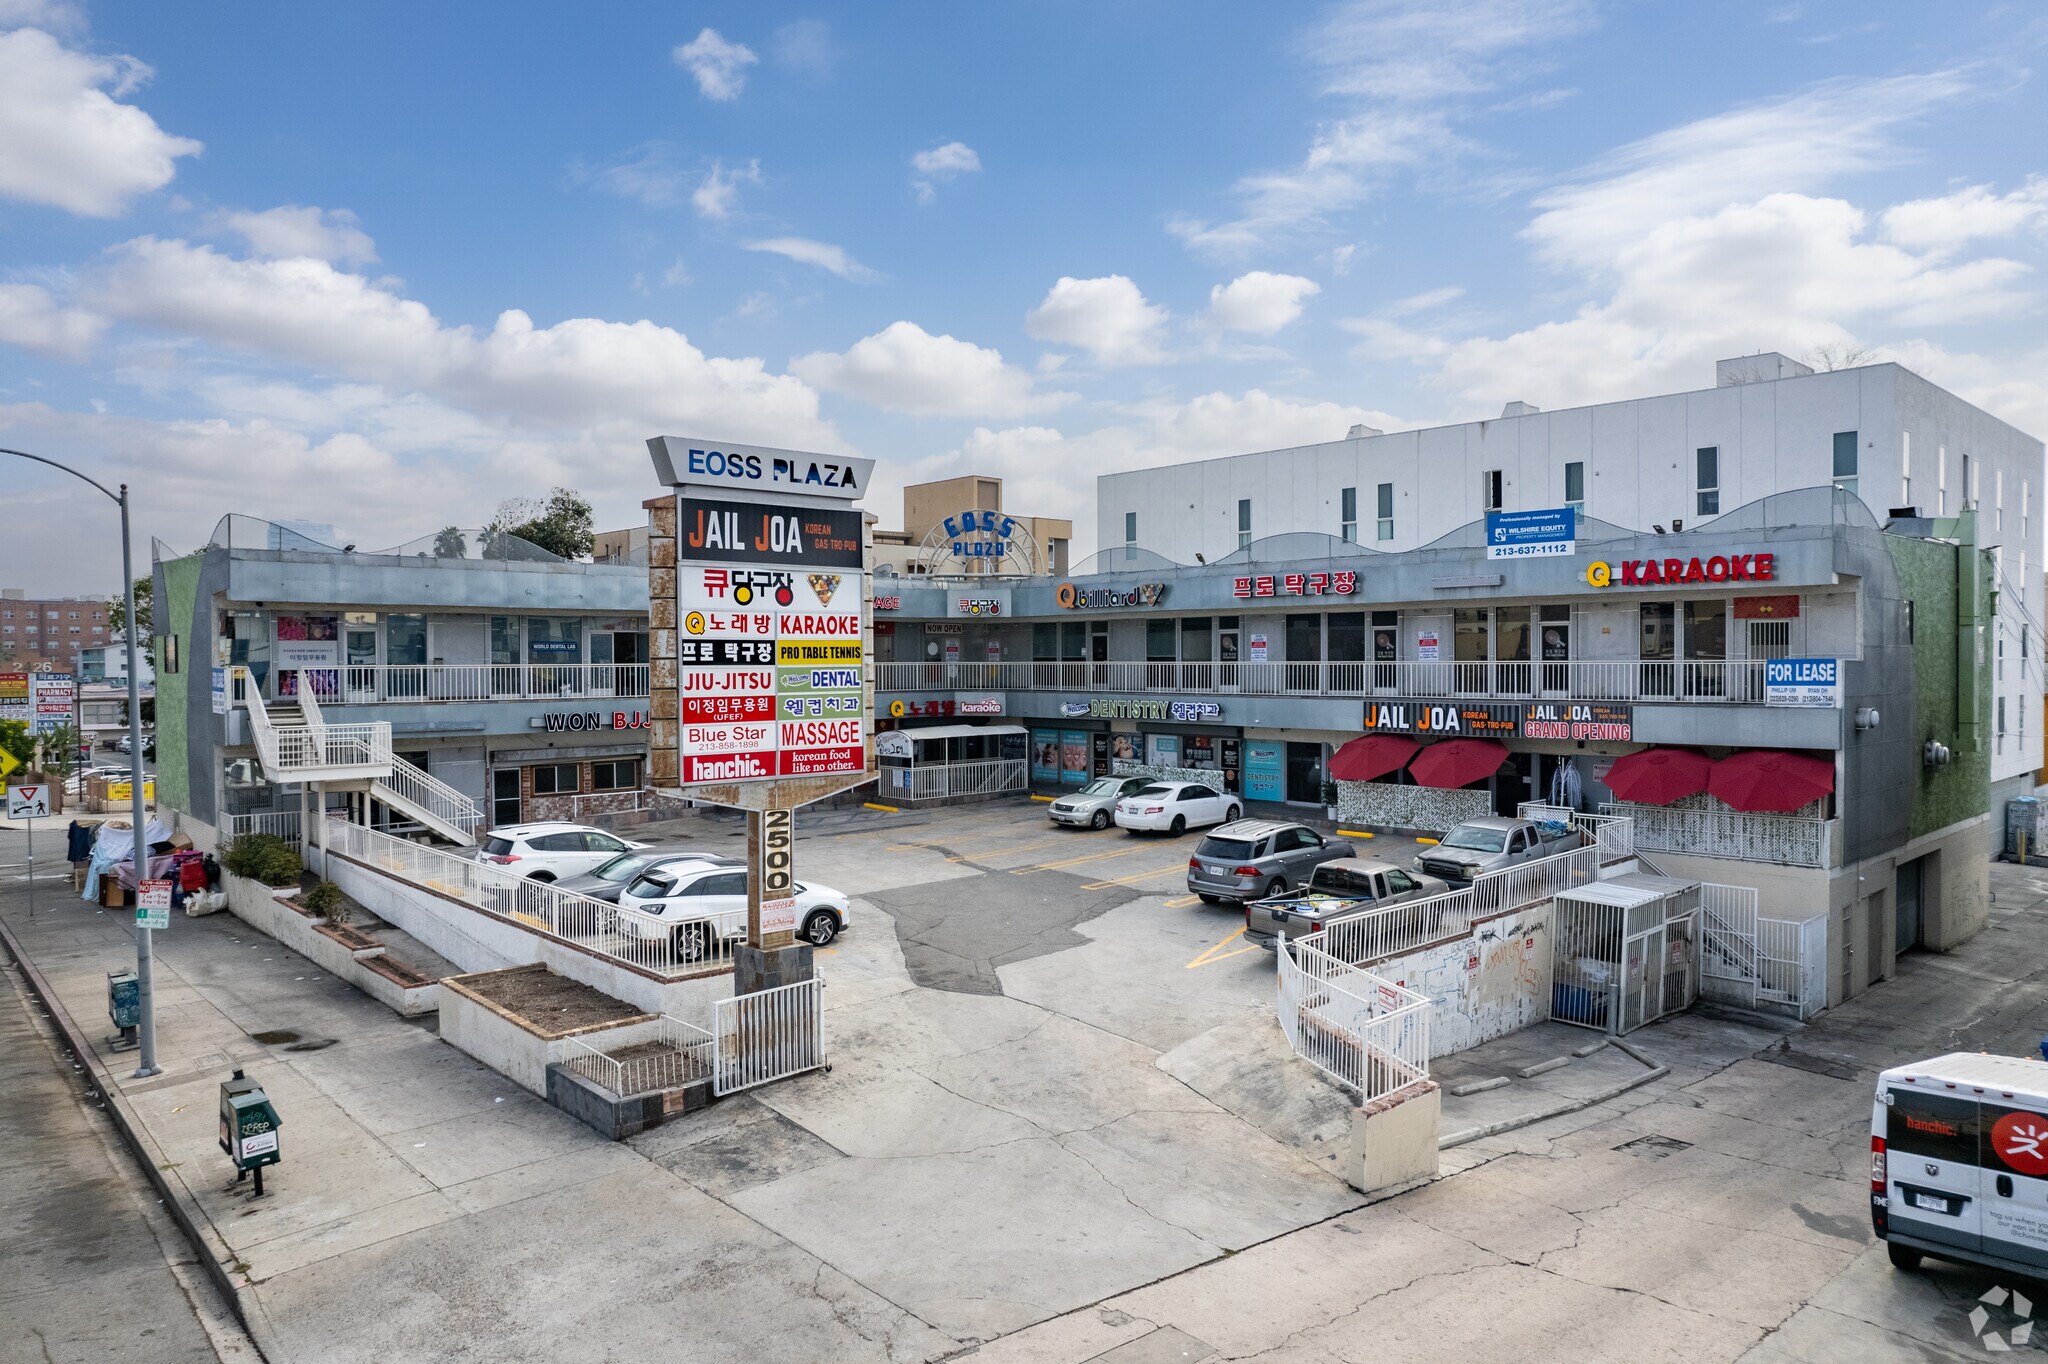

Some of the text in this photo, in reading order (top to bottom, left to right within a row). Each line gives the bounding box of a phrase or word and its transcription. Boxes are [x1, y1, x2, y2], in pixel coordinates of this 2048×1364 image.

[689, 449, 858, 489] EOSS PLAZA
[689, 509, 803, 554] JAIL JOA
[804, 523, 832, 535] KOREAN
[943, 511, 1015, 539] EOSS
[1508, 524, 1567, 534] WILSHIRE EQUITY
[953, 542, 1004, 556] PLAZA
[1496, 544, 1567, 556] 213-637-1112
[1586, 553, 1775, 588] Q KARAOKE
[703, 568, 794, 607] 큐당구장
[1232, 570, 1357, 598] 프로 탁구장
[1056, 582, 1140, 609] Q billiard
[958, 598, 1000, 616] 큐당구장
[710, 613, 771, 634] 노래방
[780, 615, 859, 635] KARAOKE
[926, 624, 962, 632] NOW OPEN
[682, 642, 772, 663] 프로 탁구장
[781, 646, 860, 660] PRO TABLE TENNIS
[684, 672, 772, 690] JIU-JITSU
[788, 670, 861, 687] Welcome DENTAL
[1768, 664, 1835, 682] FOR LEASE
[688, 698, 769, 714] 이정임무용원
[784, 698, 858, 715] 웰컴치과
[890, 700, 1001, 717] Q 노래방 karaoke
[1066, 699, 1220, 721] Welcome DENTISTRY 웰컴치과
[1462, 711, 1488, 719] KOREAN
[1527, 704, 1592, 721] JAIL JOA
[544, 712, 601, 732] WON
[1364, 705, 1460, 731] JAIL JOA
[689, 726, 766, 742] Blue Star
[782, 721, 860, 746] MASSAGE
[1525, 721, 1631, 741] GRAND OPENING
[698, 740, 759, 751] 213-858-1898
[792, 749, 850, 762] korean food
[692, 754, 766, 781] hanchic.
[792, 760, 855, 774] like no other.
[766, 810, 789, 890] 2500
[1990, 1210, 2002, 1220] tag
[2015, 1215, 2036, 1226] when
[2038, 1221, 2048, 1229] yo
[2038, 1226, 2048, 1236] the
